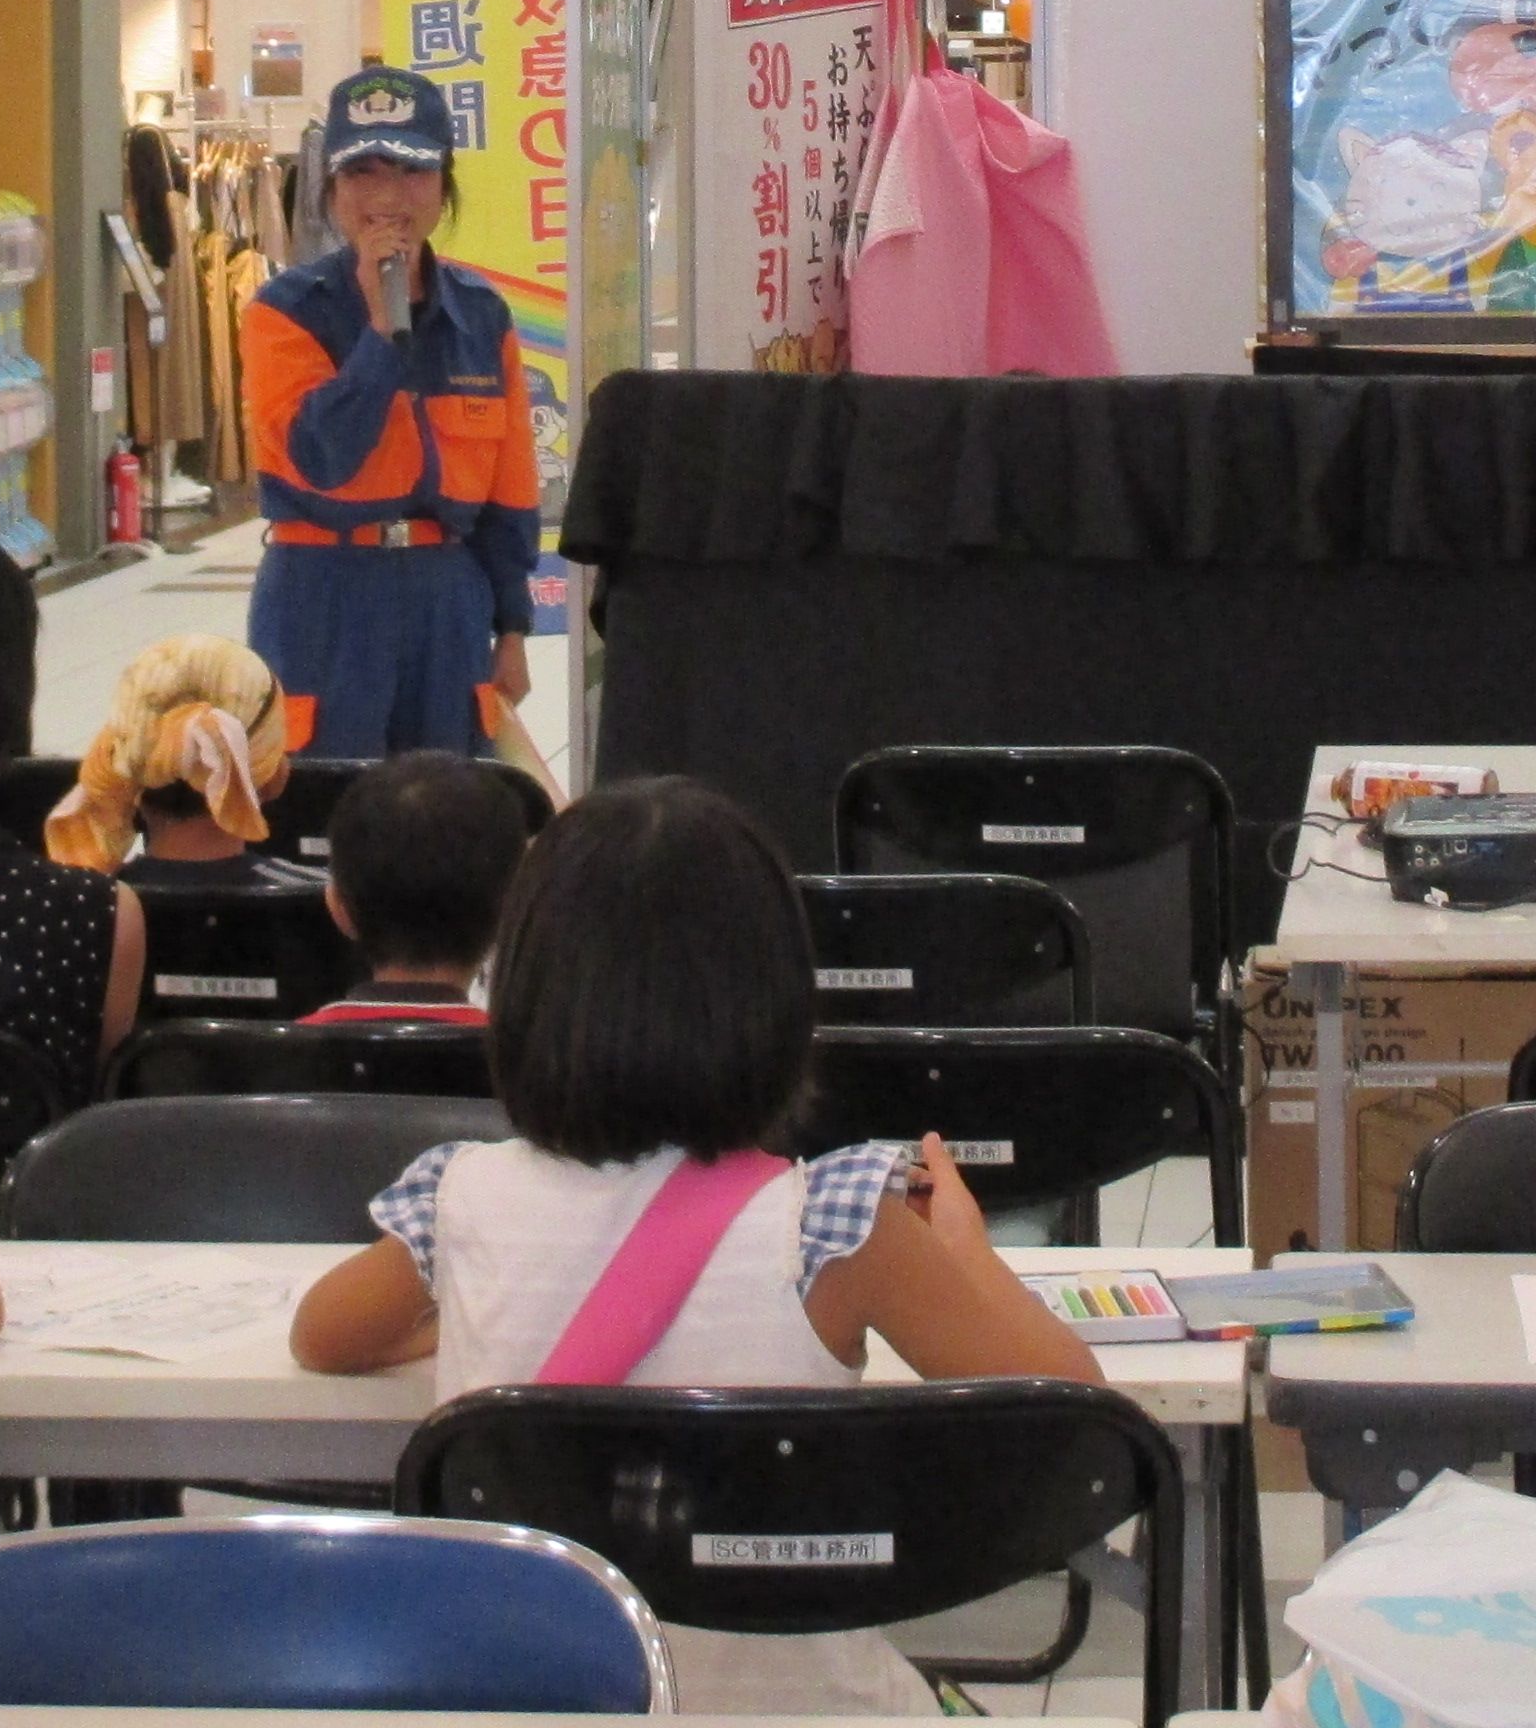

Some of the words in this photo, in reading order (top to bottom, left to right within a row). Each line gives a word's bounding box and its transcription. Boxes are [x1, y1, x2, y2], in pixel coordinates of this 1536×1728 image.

[747, 40, 792, 323] 30%割引
[714, 1537, 871, 1561] SC管理事務所
